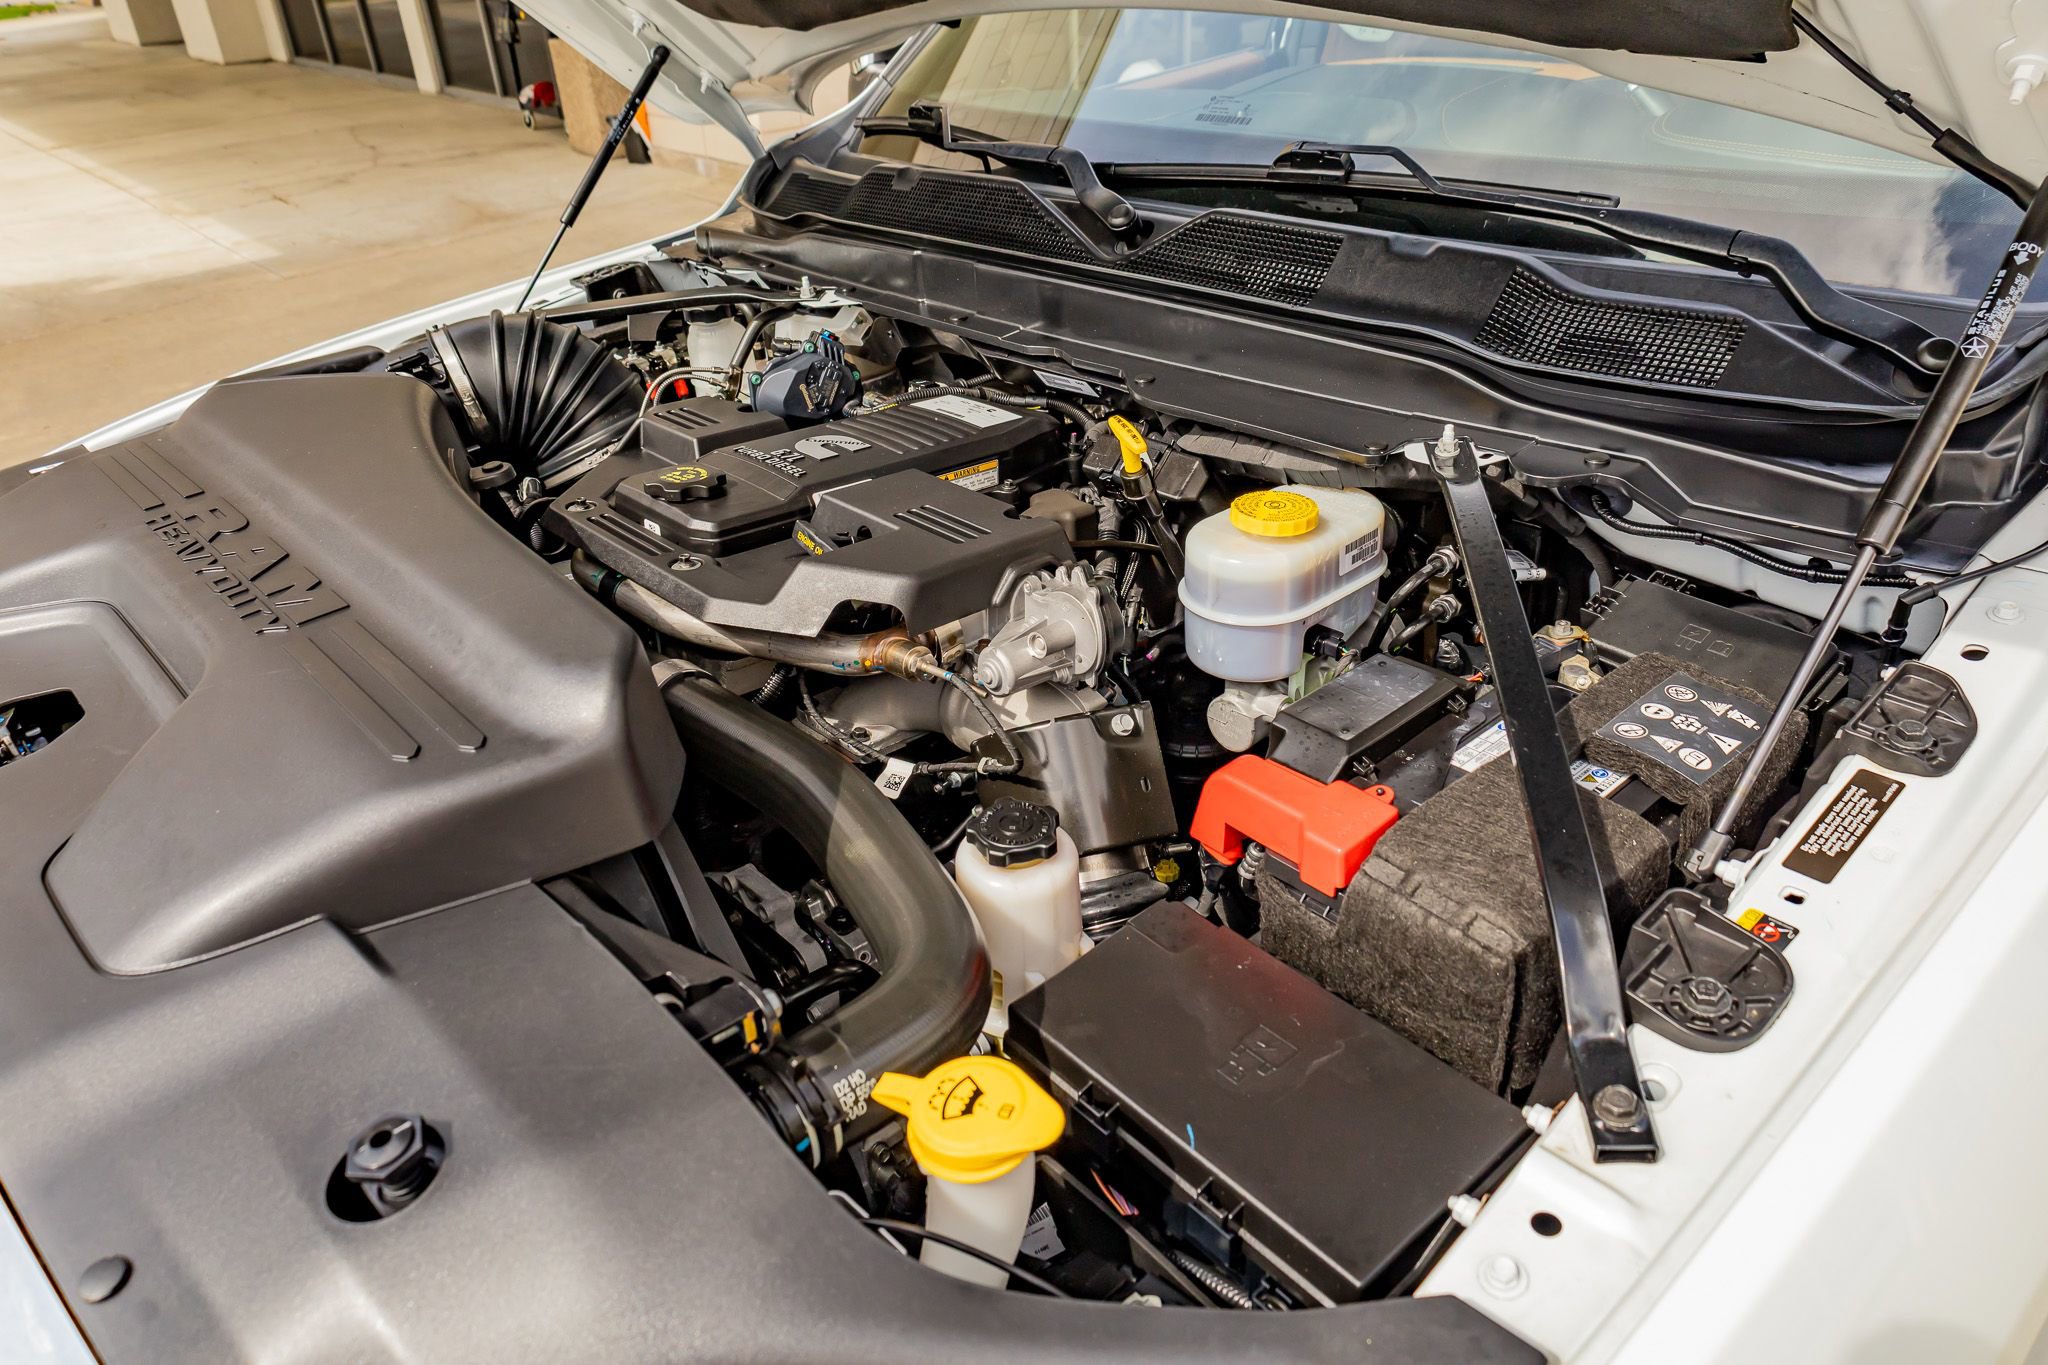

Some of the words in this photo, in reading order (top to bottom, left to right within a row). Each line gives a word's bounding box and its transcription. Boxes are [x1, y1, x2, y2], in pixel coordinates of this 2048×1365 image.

[2009, 242, 2045, 258] BODY
[1967, 269, 2008, 335] STABILUS
[733, 445, 772, 460] TURBO
[765, 457, 807, 477] DIESEL
[953, 466, 980, 480] WARNING
[797, 530, 816, 550] ENGINE
[145, 513, 227, 576] HEAVY
[205, 572, 290, 635] DUTY
[176, 497, 350, 628] RAM
[833, 1078, 851, 1098] D2
[848, 1069, 866, 1089] HO
[840, 1091, 856, 1113] DP
